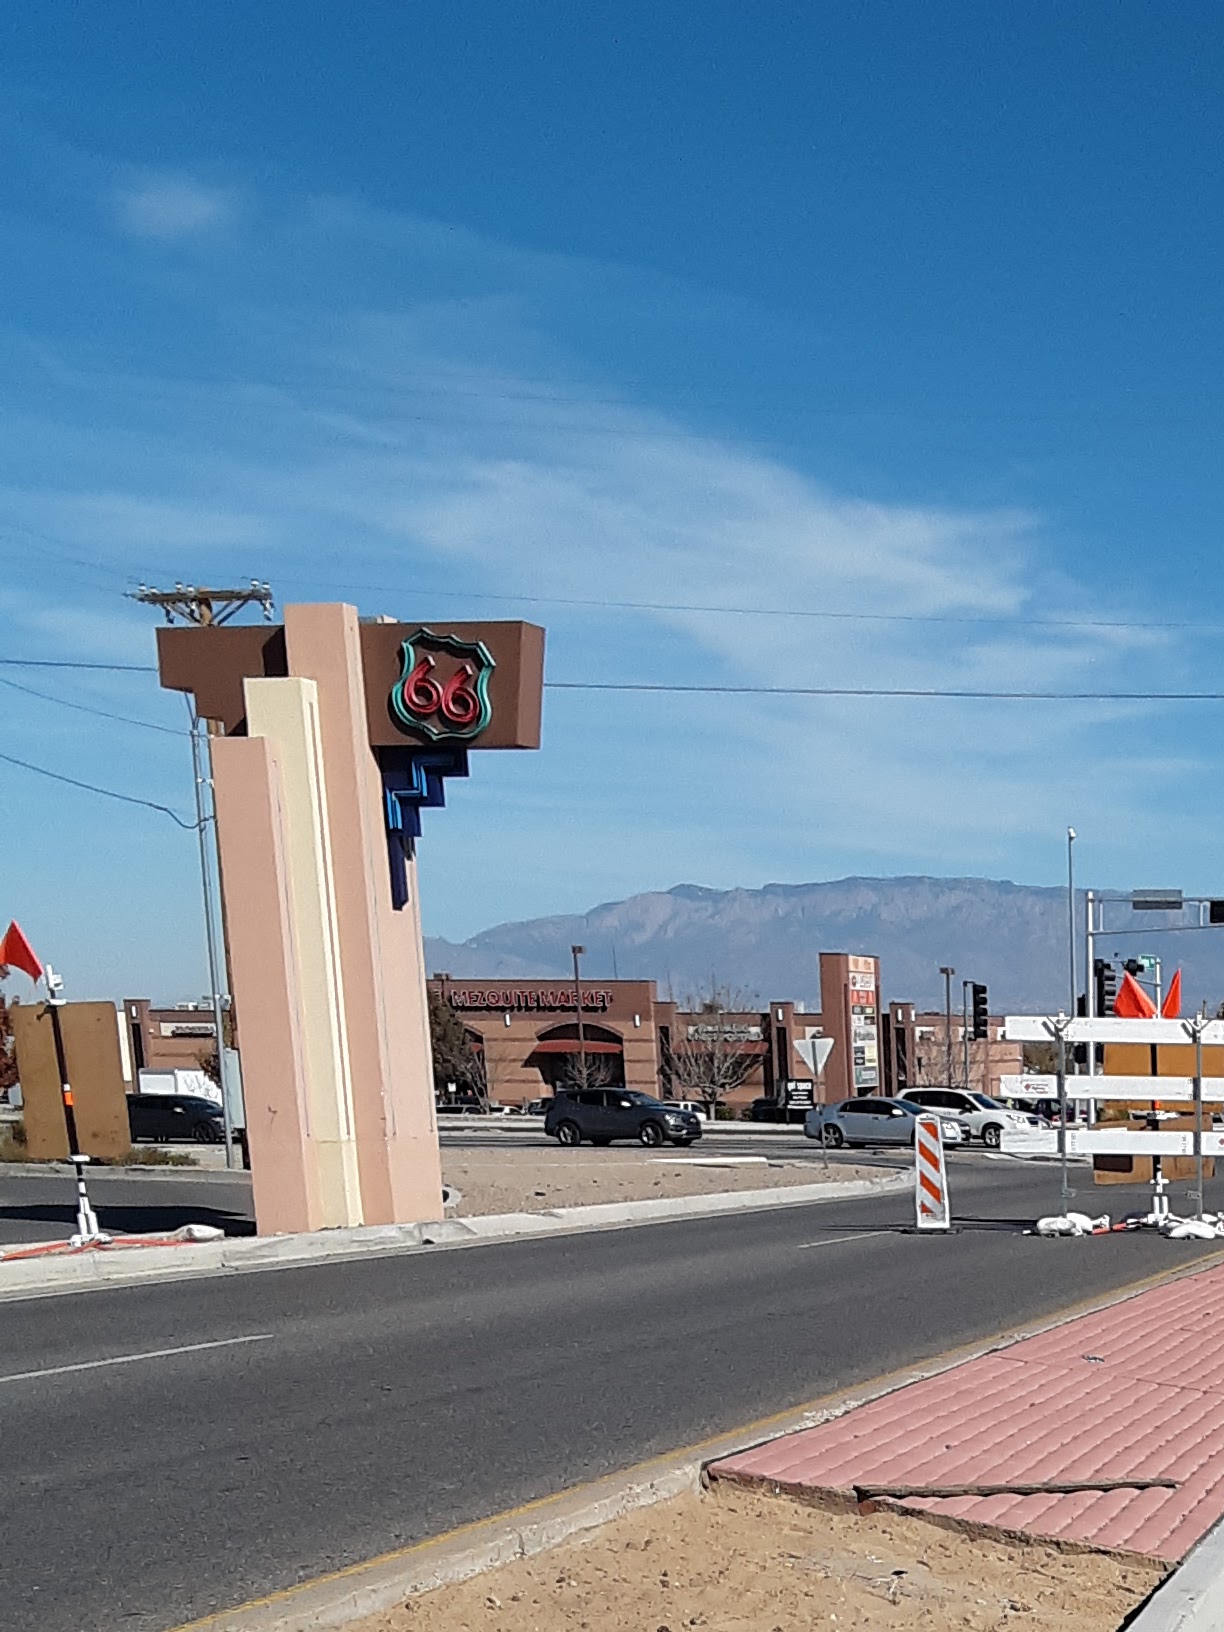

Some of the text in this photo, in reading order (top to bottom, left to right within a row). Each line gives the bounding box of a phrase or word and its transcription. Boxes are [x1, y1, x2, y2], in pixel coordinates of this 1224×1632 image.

[404, 655, 480, 723] 66
[451, 989, 538, 1007] MEZQUITE
[538, 989, 613, 1007] MARKET
